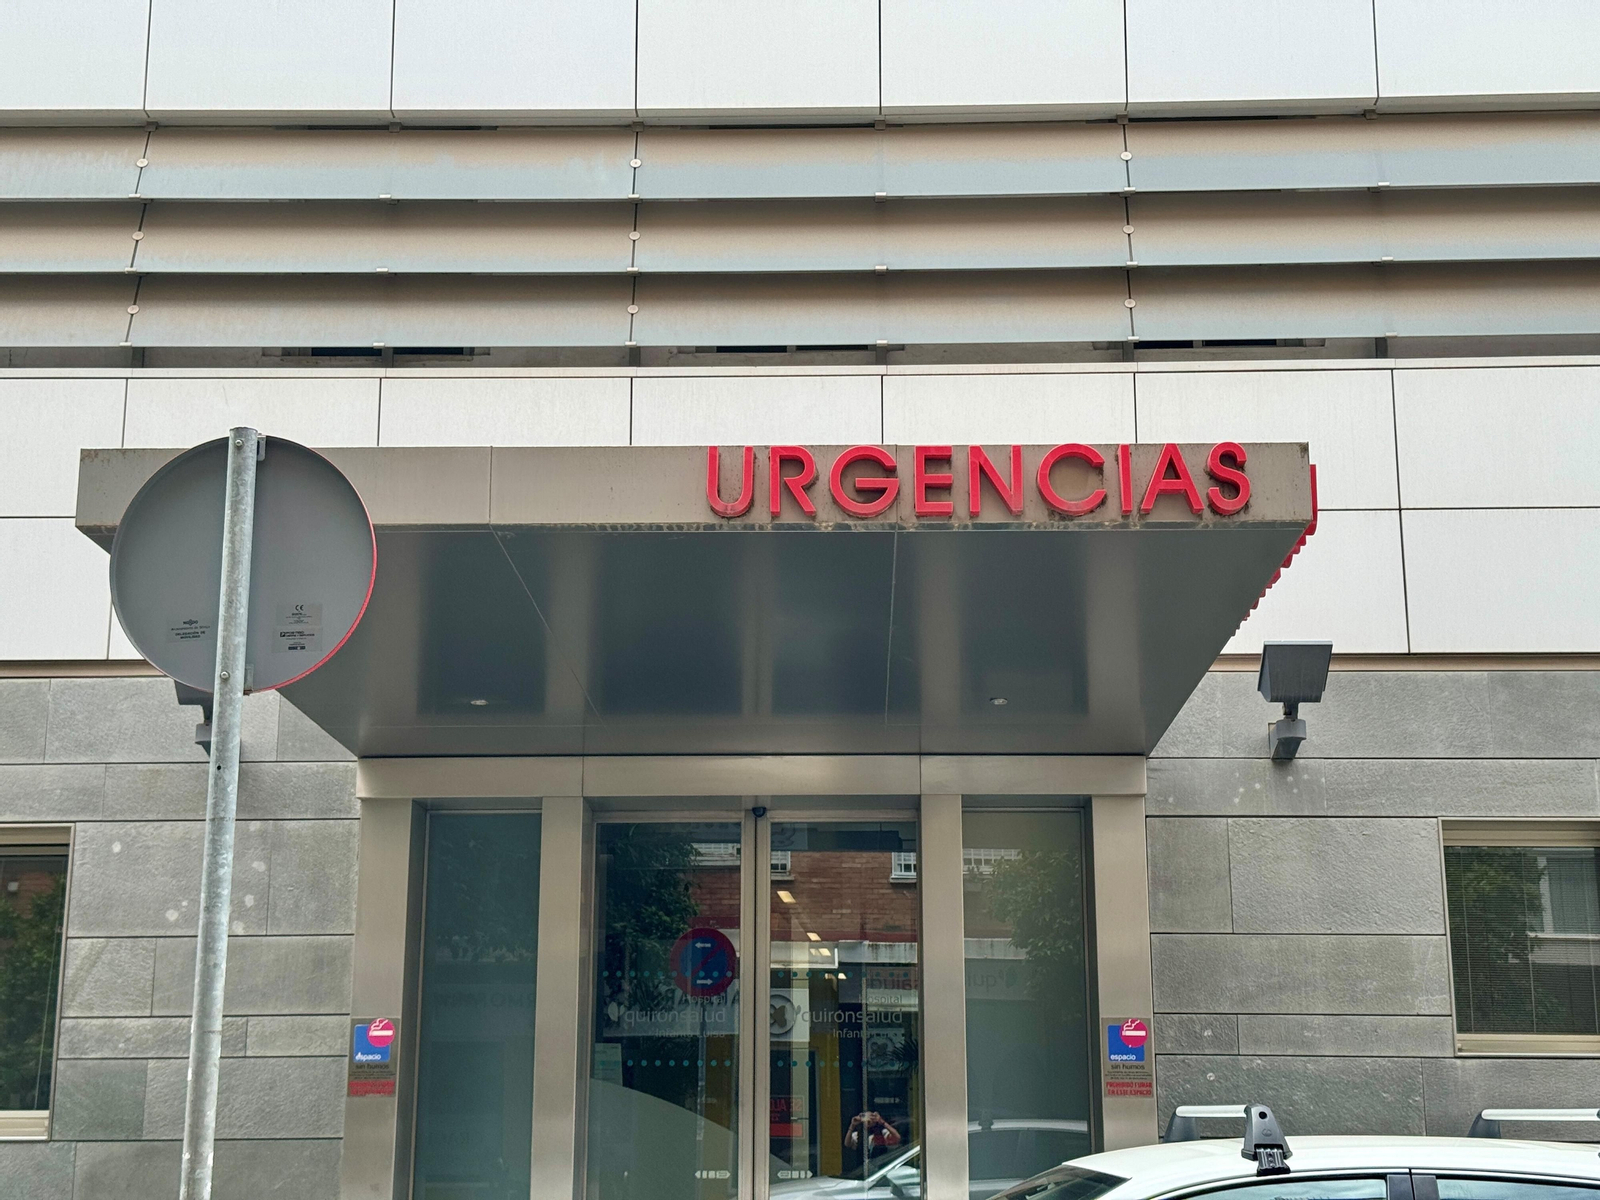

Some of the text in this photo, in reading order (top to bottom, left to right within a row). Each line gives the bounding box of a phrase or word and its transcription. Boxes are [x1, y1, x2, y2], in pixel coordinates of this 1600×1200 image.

[706, 442, 1251, 517] URGENCIAS
[682, 993, 726, 1006] Hospital
[858, 993, 903, 1006] Hospital
[1111, 1054, 1136, 1062] espacio
